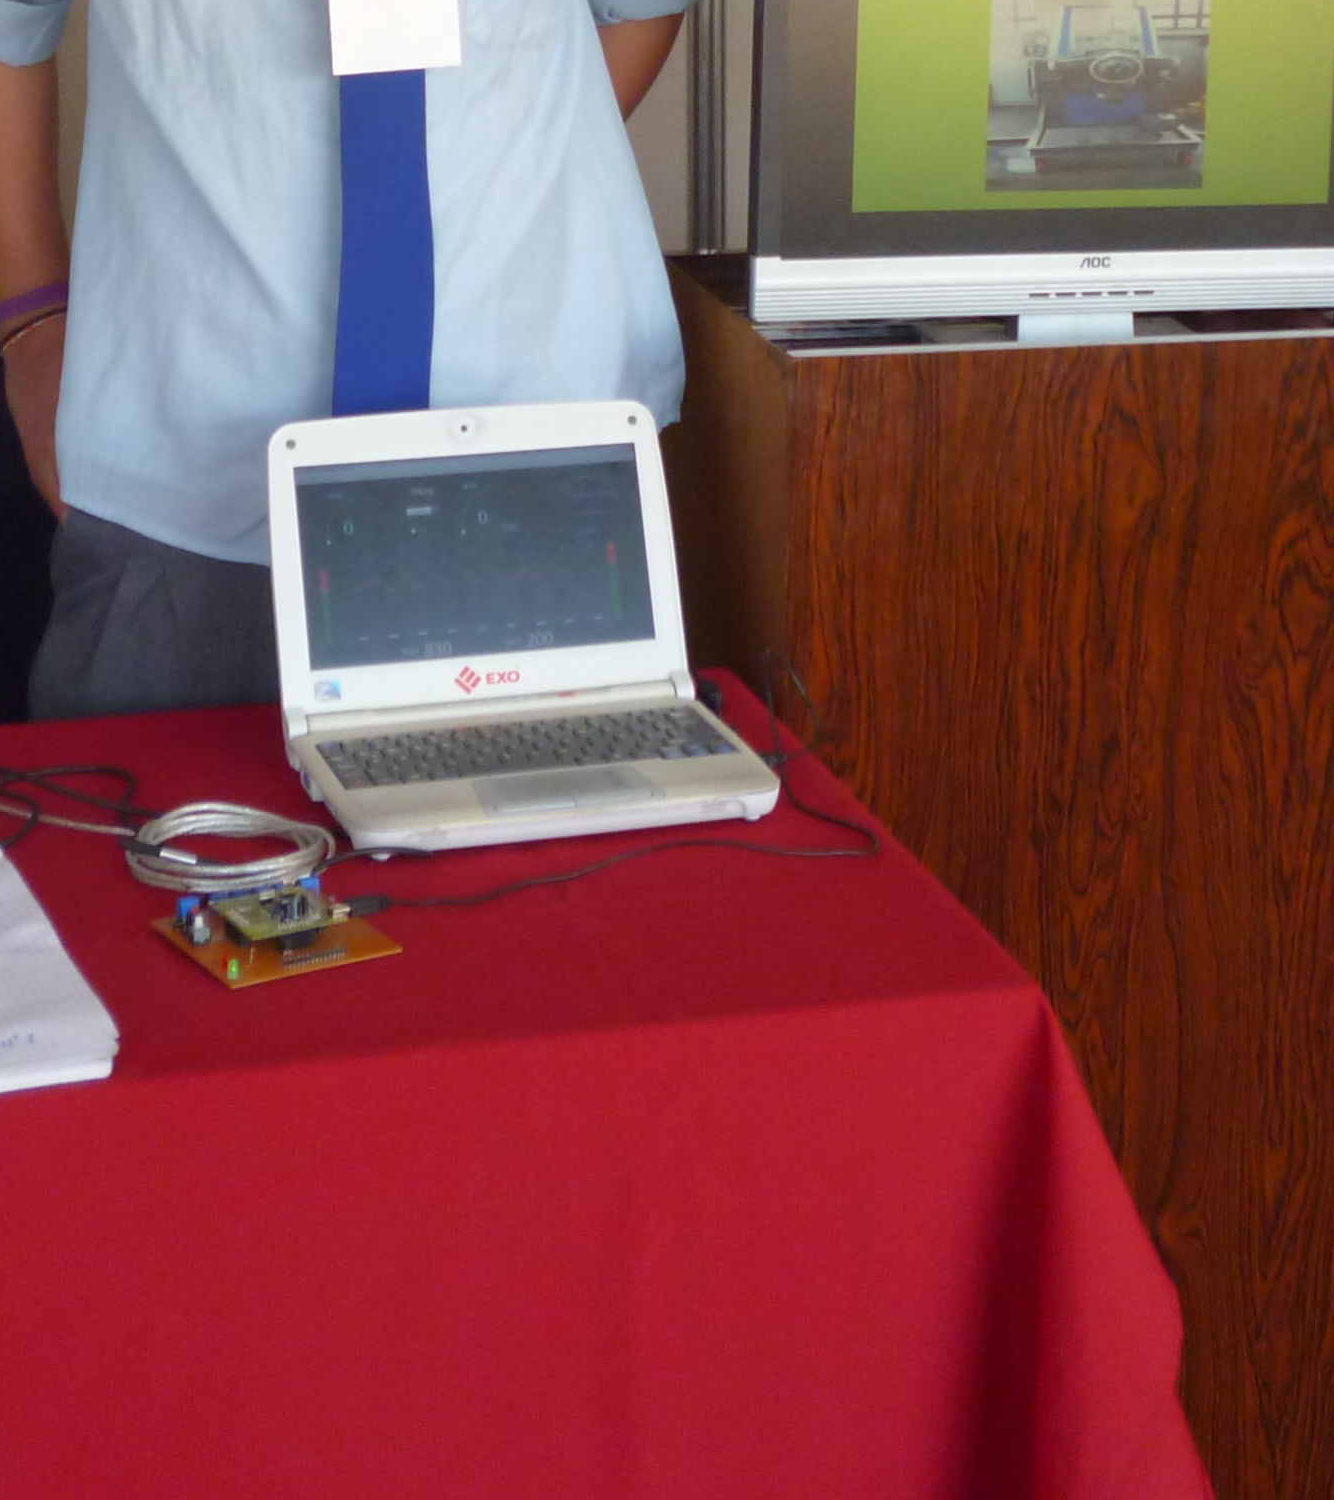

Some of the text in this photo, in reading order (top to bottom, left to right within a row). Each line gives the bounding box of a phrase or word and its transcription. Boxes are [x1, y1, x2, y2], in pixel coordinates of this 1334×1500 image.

[1079, 256, 1112, 269] AOC
[526, 632, 554, 648] 200
[485, 670, 521, 686] EXO
